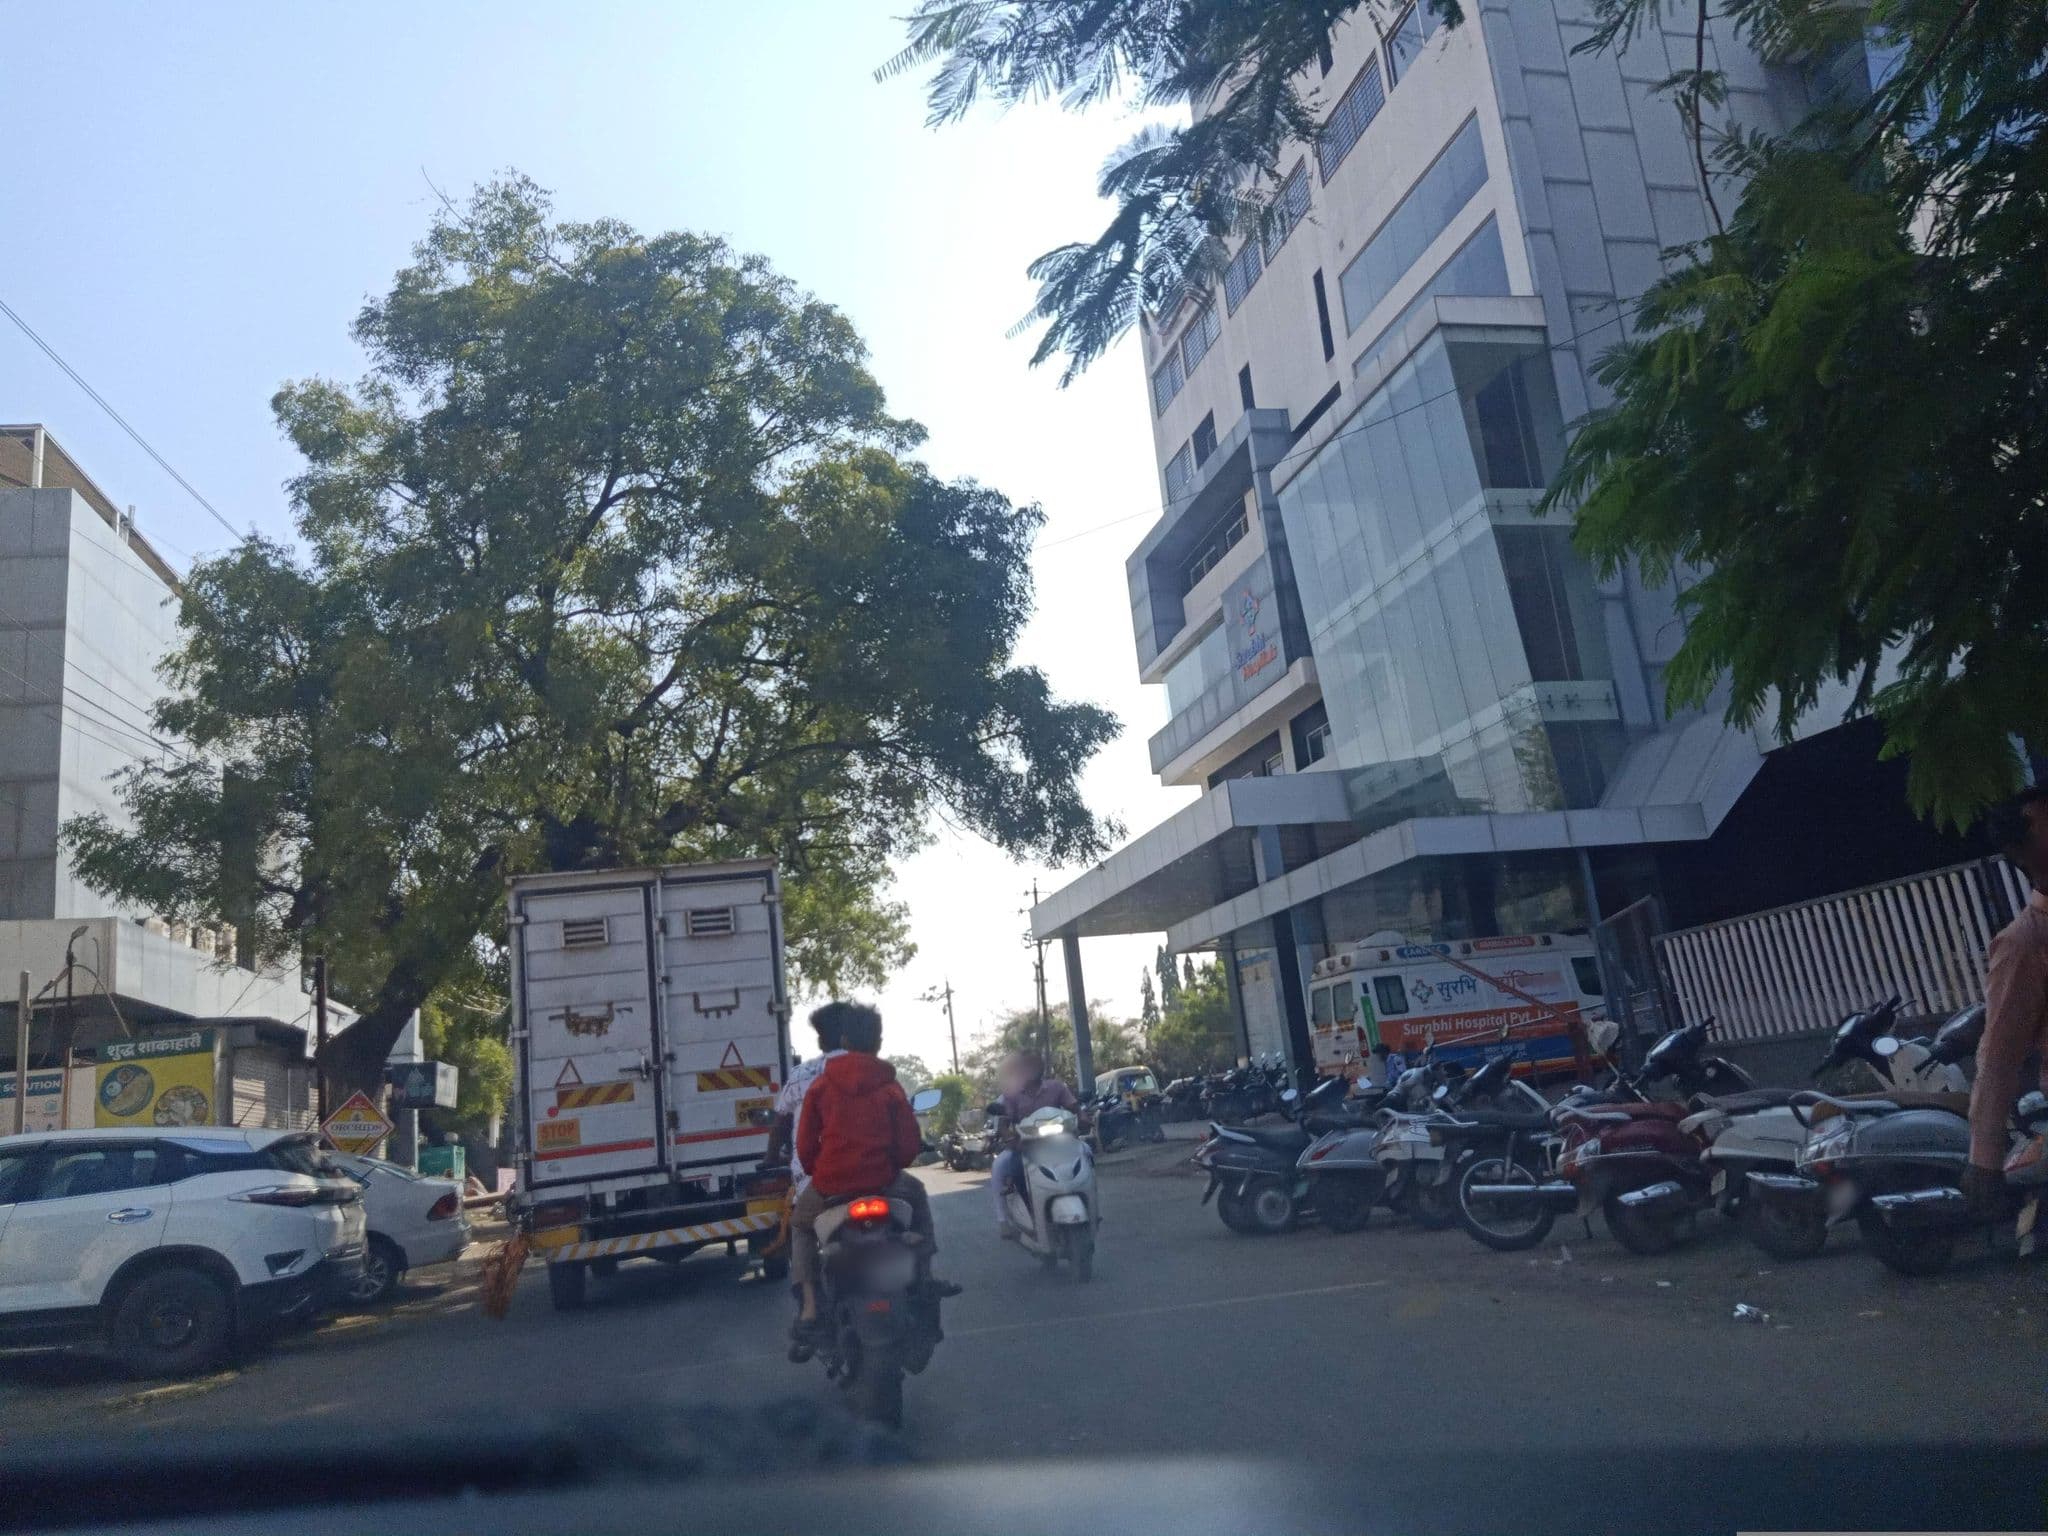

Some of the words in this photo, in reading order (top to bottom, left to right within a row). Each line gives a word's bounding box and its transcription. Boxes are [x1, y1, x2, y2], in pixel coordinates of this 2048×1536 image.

[1436, 974, 1477, 1001] सुरभि
[1403, 1018, 1452, 1036] Surabhi
[1455, 1014, 1507, 1031] Hospital
[107, 1043, 136, 1061] शुद्ध
[138, 1032, 202, 1054] शाकाहारी
[3, 1079, 61, 1093] SOUTION
[540, 1120, 577, 1139] STOP
